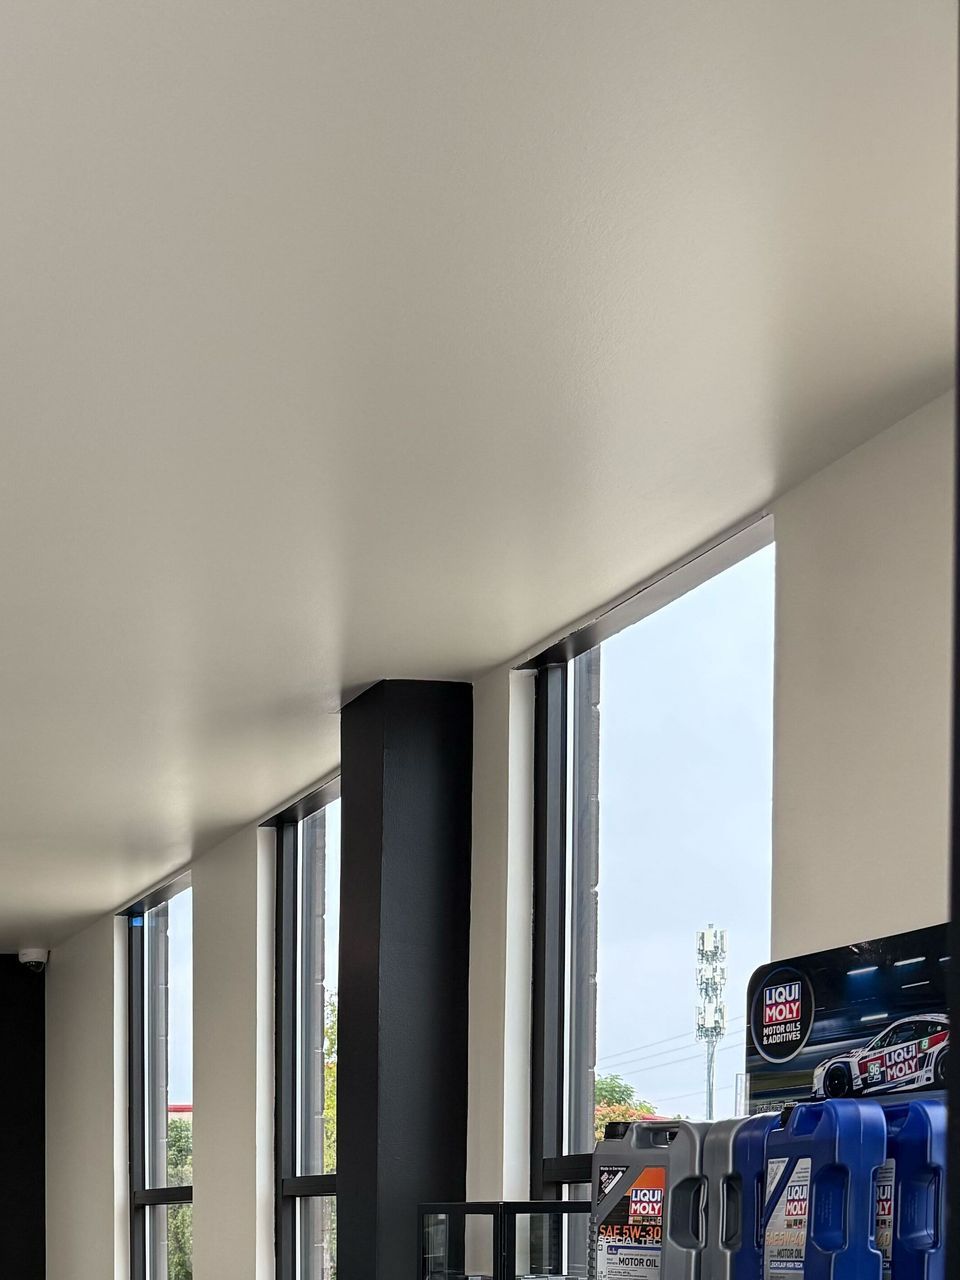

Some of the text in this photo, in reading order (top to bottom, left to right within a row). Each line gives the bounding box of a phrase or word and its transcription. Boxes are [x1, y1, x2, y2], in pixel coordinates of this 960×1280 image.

[765, 983, 800, 1005] LIQUI
[765, 1002, 800, 1023] MOLY
[763, 1021, 801, 1036] MOTOR OILS
[763, 1031, 801, 1045] & ADDITIVES
[885, 1044, 917, 1066] LIQUI
[869, 1063, 880, 1077] 96
[887, 1060, 918, 1081] MOLY
[631, 1189, 662, 1202] LIQUI
[788, 1186, 808, 1200] LIQUI
[630, 1202, 662, 1215] MOLY
[786, 1201, 807, 1215] MOLY
[600, 1225, 662, 1240] SAE 5W-30
[777, 1248, 804, 1259] MOTOR OIL
[618, 1257, 644, 1268] MOTOR
[645, 1258, 659, 1268] OIL
